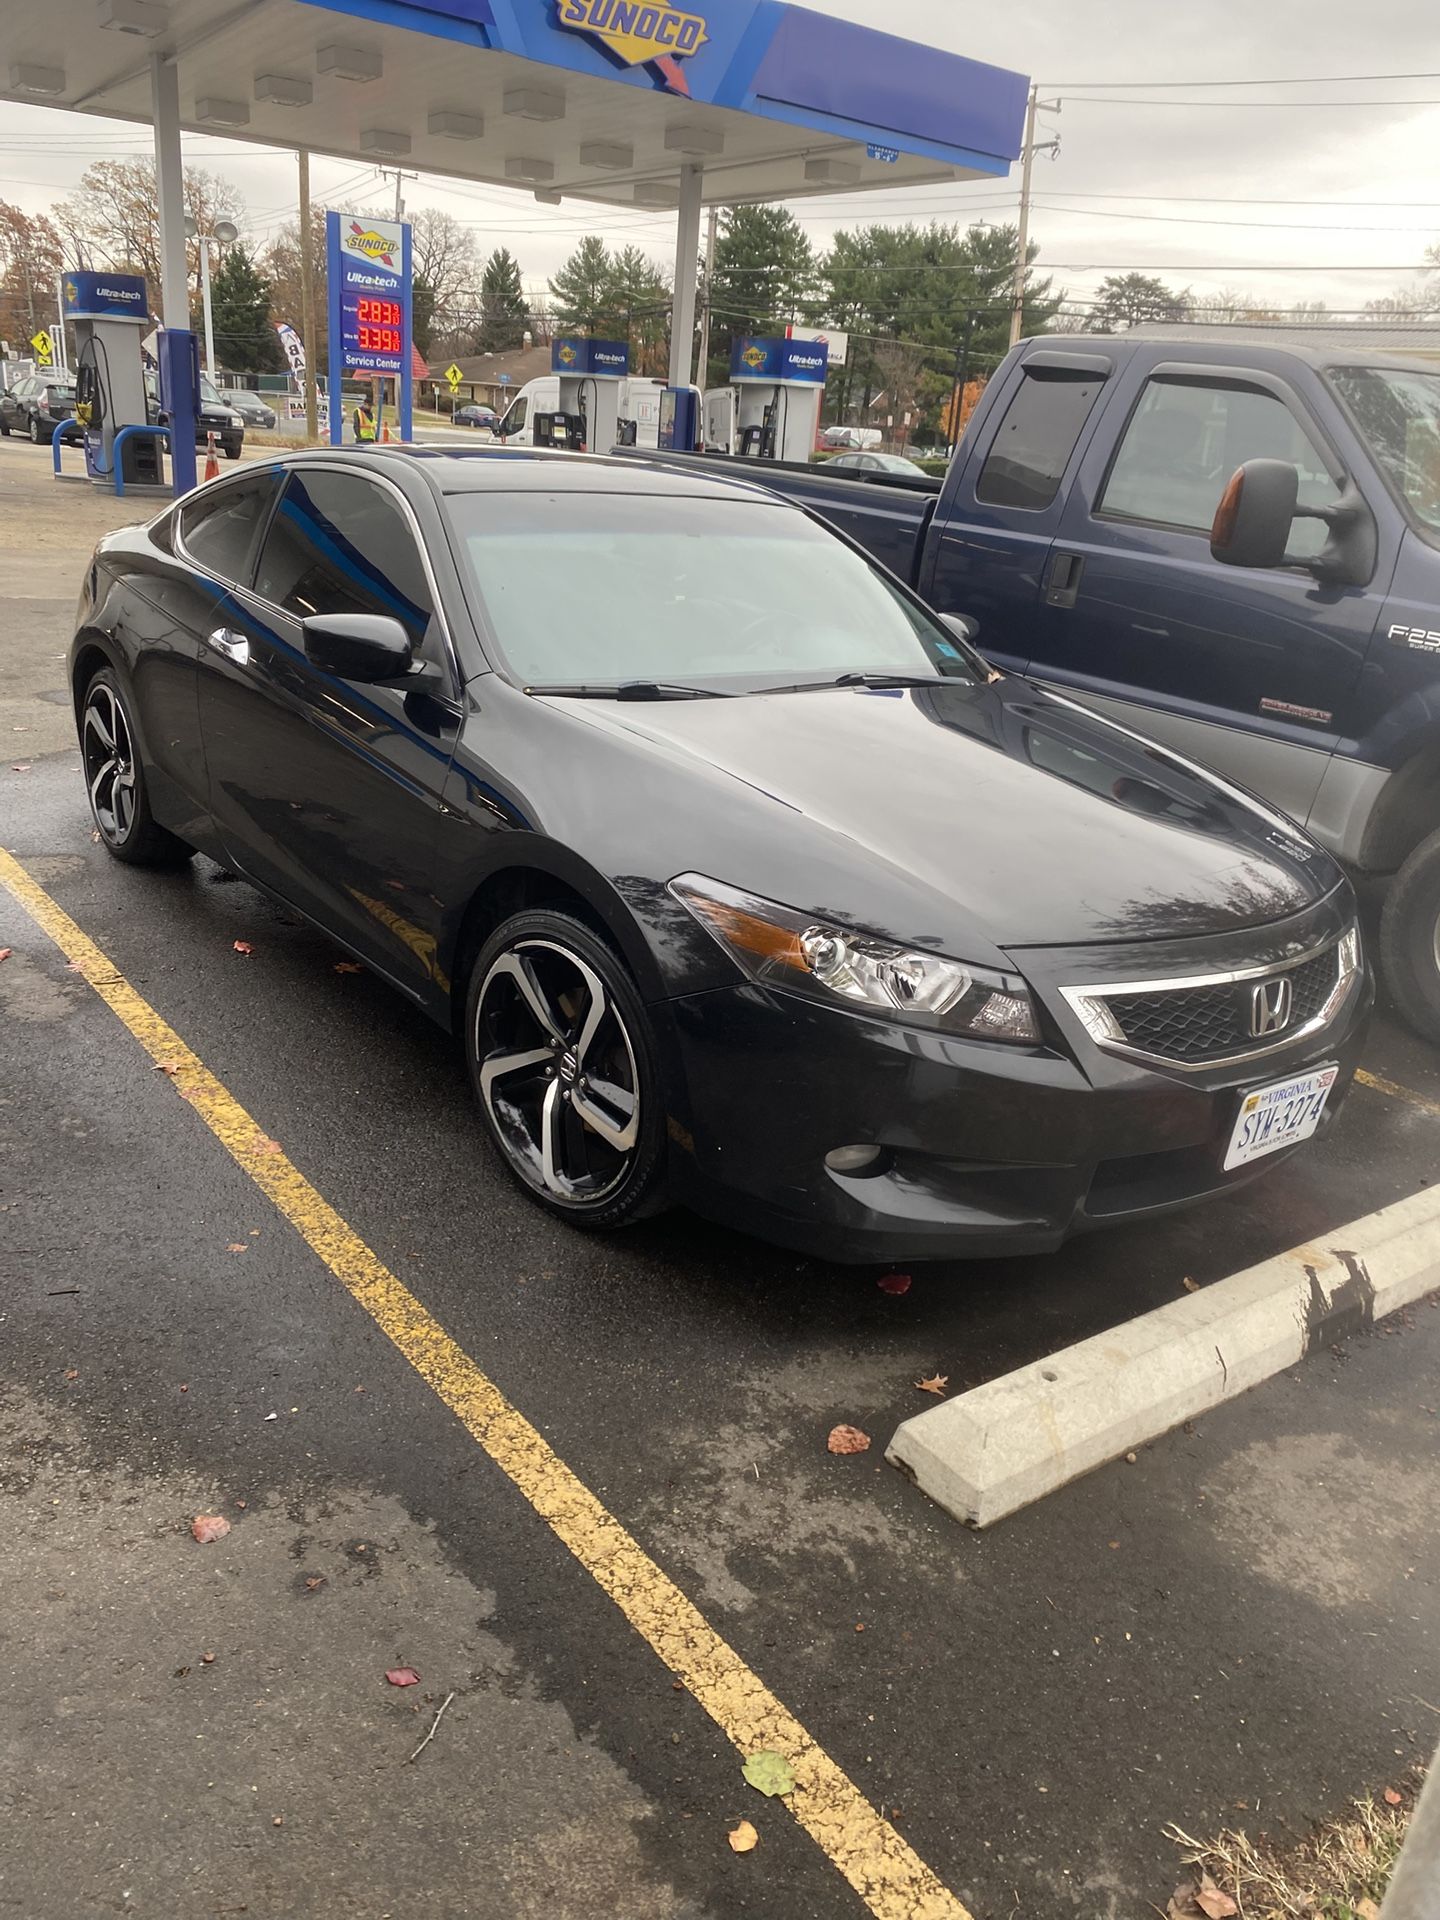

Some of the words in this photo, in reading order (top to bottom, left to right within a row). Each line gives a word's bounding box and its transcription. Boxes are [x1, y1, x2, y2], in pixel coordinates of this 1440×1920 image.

[565, 0, 702, 50] SUNOCO
[350, 236, 395, 252] SUNOCO
[358, 299, 392, 325] 2.83
[359, 326, 392, 351] 3.39
[345, 354, 375, 367] Service
[376, 357, 401, 369] Center
[1267, 1080, 1312, 1104] VIRGINIA
